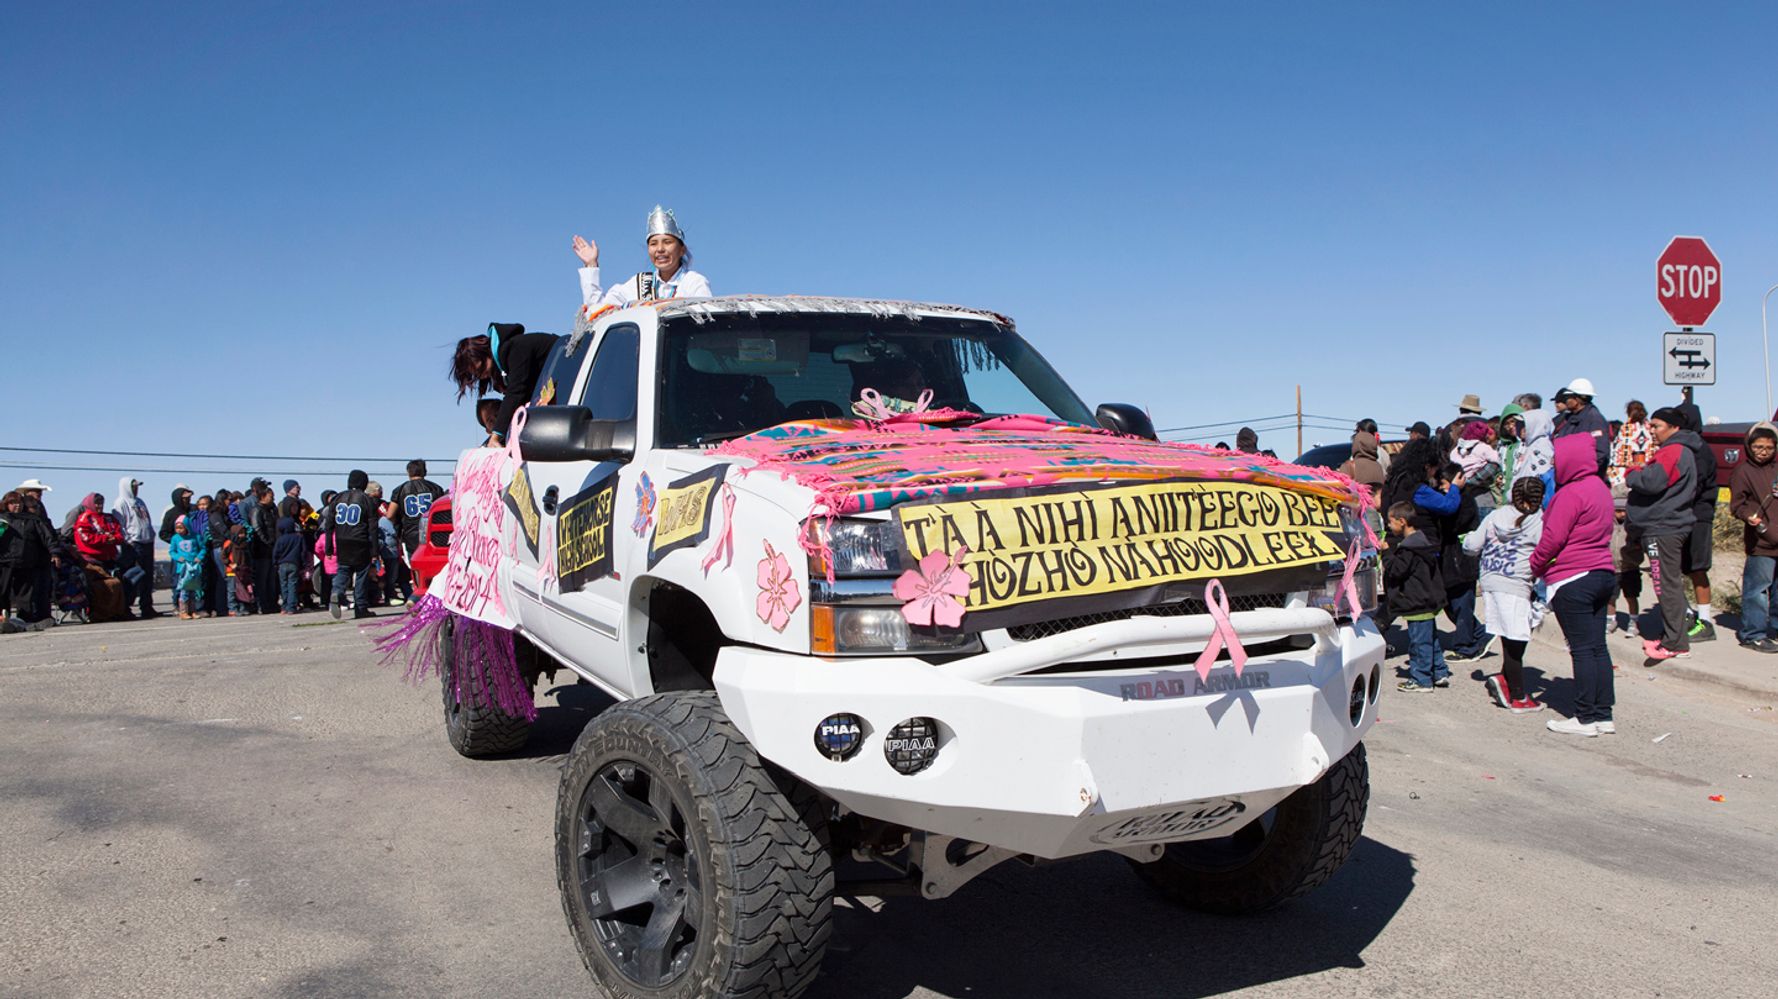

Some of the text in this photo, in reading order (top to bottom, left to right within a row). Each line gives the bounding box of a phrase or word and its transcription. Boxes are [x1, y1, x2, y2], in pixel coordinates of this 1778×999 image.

[1661, 263, 1718, 299] STOP
[1676, 338, 1704, 346] DIVIDED
[1675, 371, 1706, 379] HIGHWAY
[336, 503, 362, 526] 30
[404, 493, 432, 518] 65
[560, 491, 612, 547] WHITEHORSE
[1013, 491, 1099, 547] NIHÌ
[1279, 491, 1341, 529] BEE
[576, 527, 605, 570] SCHOOL
[961, 541, 1098, 606] HÒZHÒ
[1120, 671, 1271, 702] ROAD ARMOR
[822, 724, 861, 736] PIAA
[888, 737, 935, 752] PIAA
